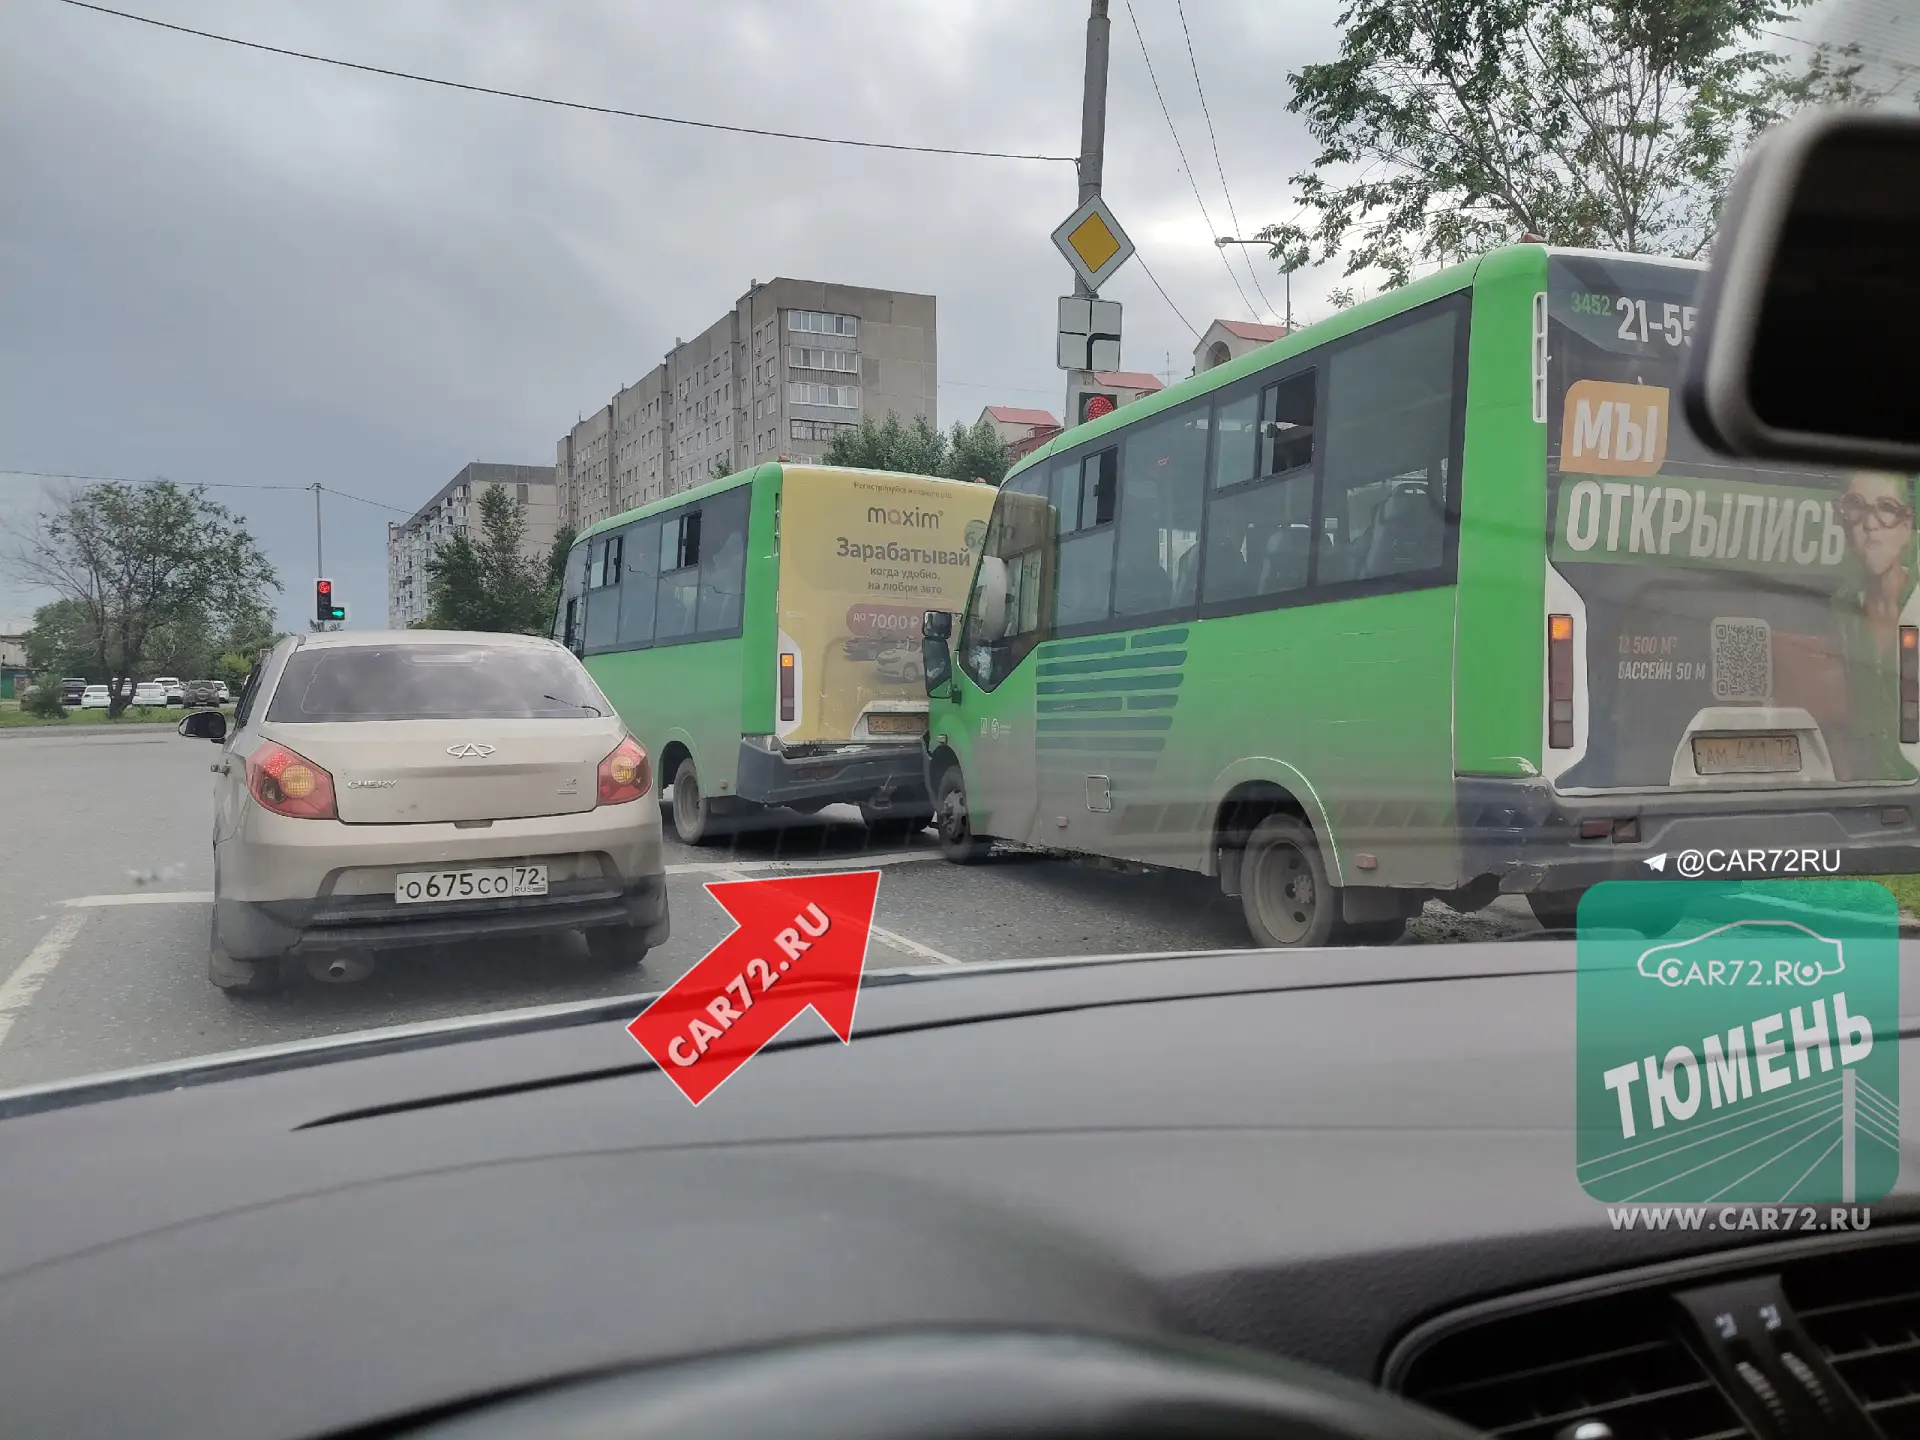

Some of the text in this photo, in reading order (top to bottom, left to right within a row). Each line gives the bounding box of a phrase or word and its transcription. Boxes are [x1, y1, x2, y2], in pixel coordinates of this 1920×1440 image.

[1571, 291, 1612, 316] 3452
[1573, 398, 1658, 463] МЫ
[868, 507, 940, 529] maxim
[1566, 481, 1846, 565] ОТКРЫЛИСЬ
[836, 536, 971, 567] Зарабатывай
[870, 566, 899, 578] когда
[868, 582, 942, 594] на любом авто
[853, 612, 866, 622] до
[1633, 635, 1658, 654] 500
[1618, 658, 1706, 680] БАССЕЙН 50 М
[347, 778, 397, 789] CHERY
[515, 868, 539, 886] 72
